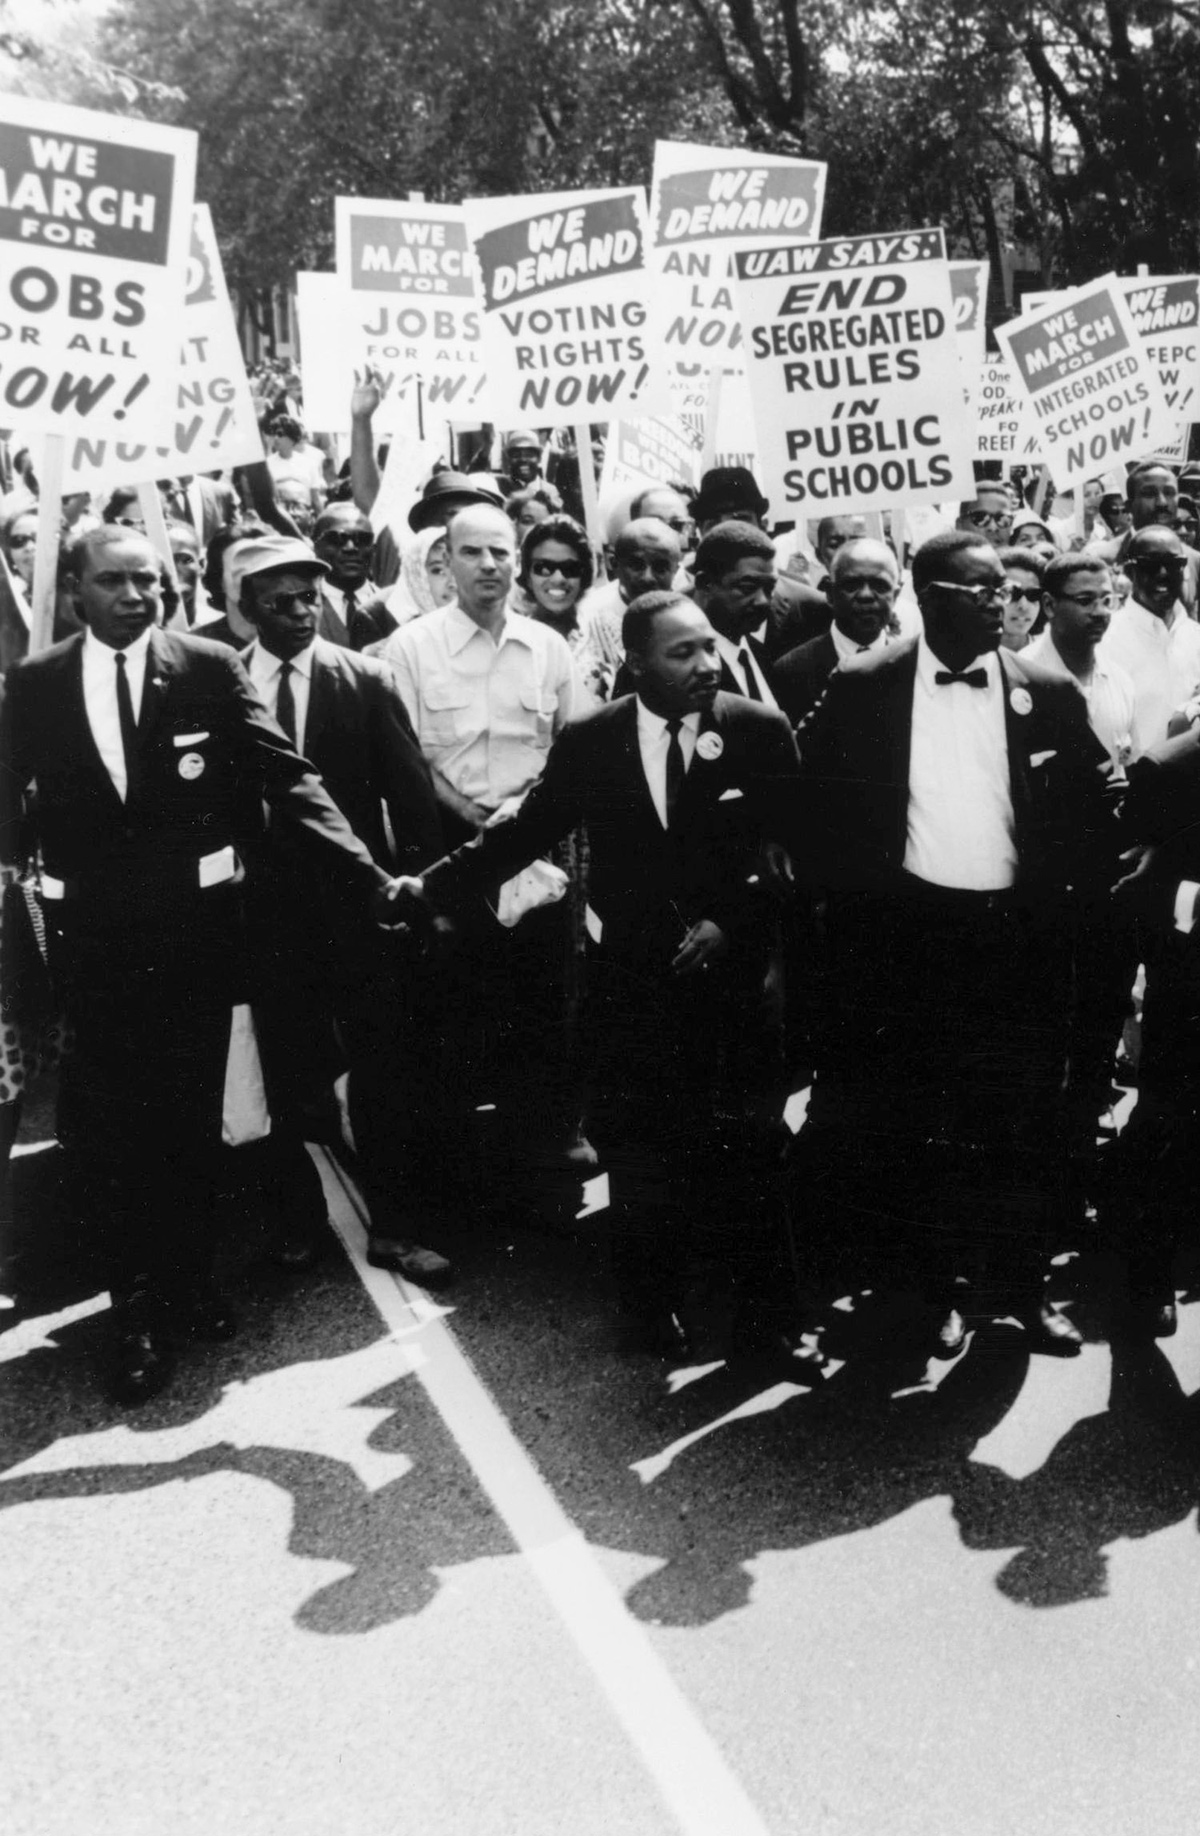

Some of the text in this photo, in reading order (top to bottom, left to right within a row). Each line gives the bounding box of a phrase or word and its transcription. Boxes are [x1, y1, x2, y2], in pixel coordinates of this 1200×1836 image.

[29, 134, 98, 178] WE
[708, 170, 769, 201] WE
[20, 217, 96, 249] FOR
[401, 222, 445, 247] WE
[527, 207, 587, 253] WE
[664, 197, 809, 239] DEMAND
[492, 229, 638, 301] DEMAND
[662, 250, 712, 278] AN
[744, 246, 821, 277] UAW
[828, 233, 937, 269] SAYS:
[9, 266, 146, 327] OBS
[400, 276, 449, 292] FOR
[690, 284, 733, 312] LA
[777, 274, 909, 317] END
[1129, 286, 1168, 315] WE
[362, 307, 481, 342] JOBS
[500, 301, 647, 336] VOTING
[751, 307, 946, 360] SEGREGATED
[1042, 309, 1079, 338] WE
[1132, 300, 1196, 333] MAND
[66, 333, 137, 359] ALL
[366, 345, 479, 363] FOR ALL
[515, 336, 645, 371] RIGHTS
[1024, 314, 1116, 375] MARCH
[1057, 351, 1095, 375] FOR
[1146, 345, 1197, 364] FEPC
[519, 363, 650, 411] NOW!
[783, 348, 921, 393] RULES
[1033, 355, 1139, 419] INTEGRATED
[0, 362, 150, 421] OW!
[831, 397, 881, 420] IN
[1045, 382, 1150, 443] SCHOOLS
[785, 415, 941, 462] PUBLIC
[1066, 406, 1152, 474] NOW!
[783, 454, 953, 503] SCHOOLS
